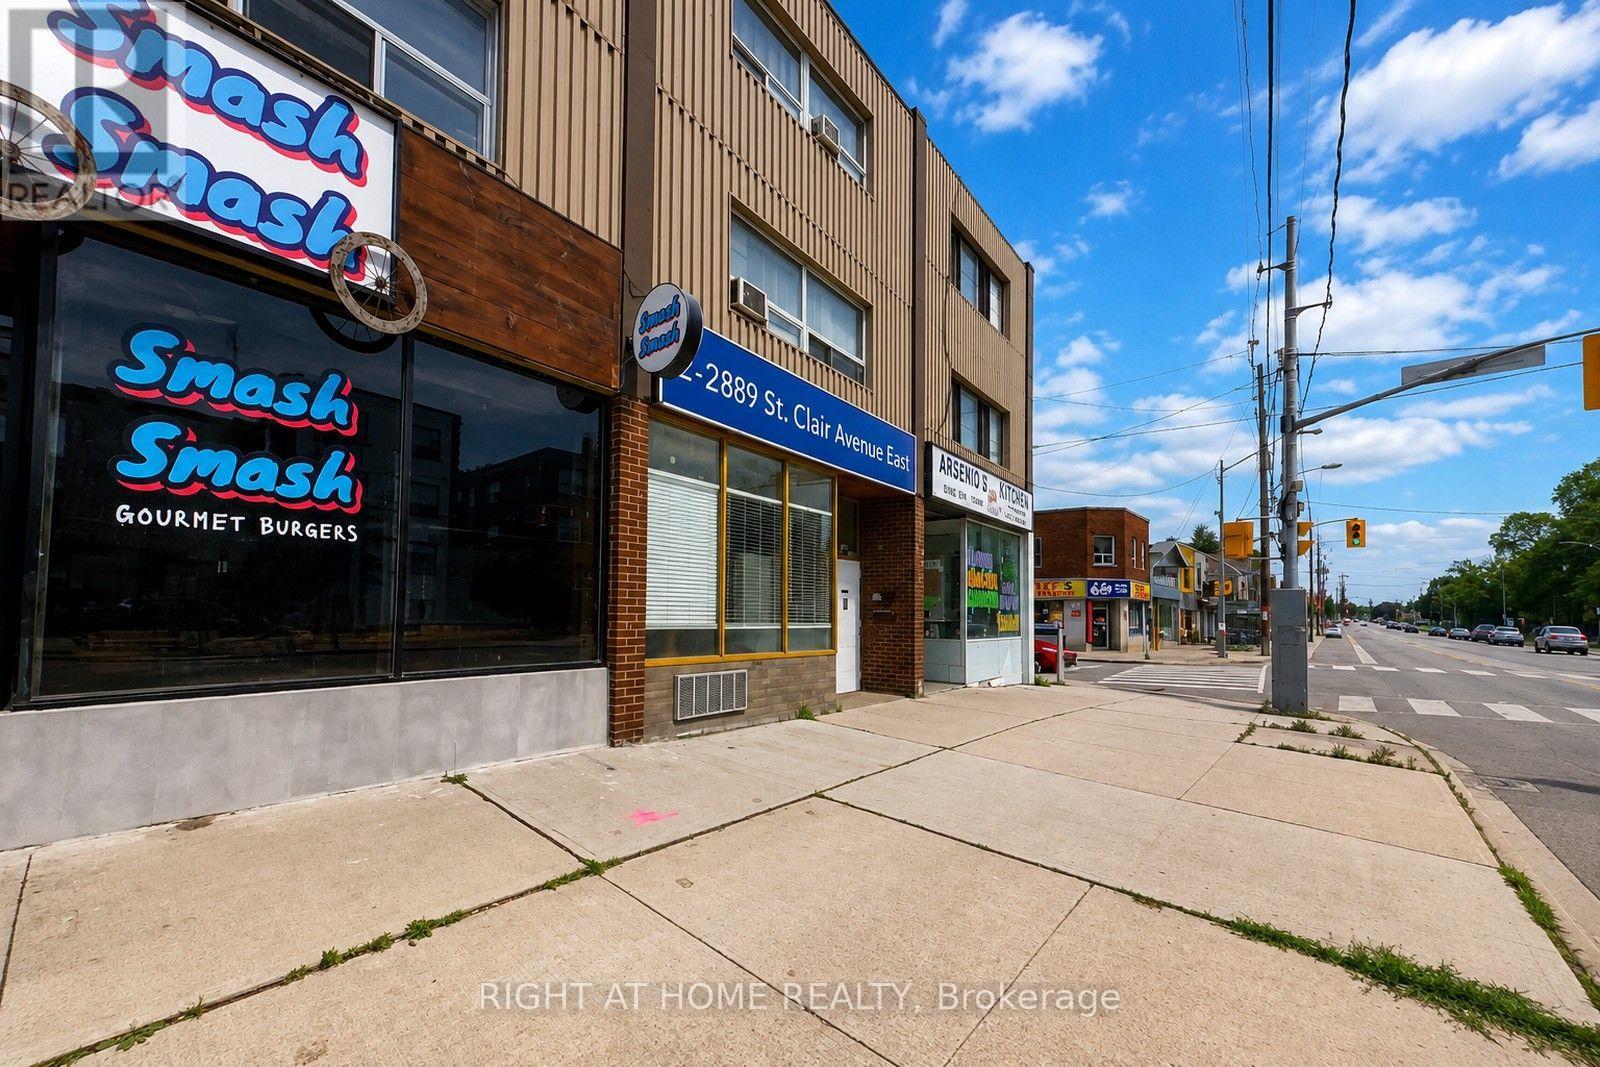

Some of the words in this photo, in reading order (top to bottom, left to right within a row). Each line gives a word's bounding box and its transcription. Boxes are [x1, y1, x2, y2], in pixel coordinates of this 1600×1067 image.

[47, 0, 368, 187] Smash
[42, 87, 367, 281] Smash
[638, 294, 681, 335] Smash
[638, 320, 681, 360] Smash
[113, 329, 358, 437] Smash
[679, 363, 758, 408] -2889
[764, 390, 788, 423] St.
[794, 404, 831, 440] Clair
[835, 424, 883, 461] Avenue
[887, 445, 911, 472] East
[115, 421, 363, 515] Smash
[999, 481, 1029, 510] KITCHEN
[116, 504, 245, 532] GOURMET
[260, 516, 358, 542] BURGERS
